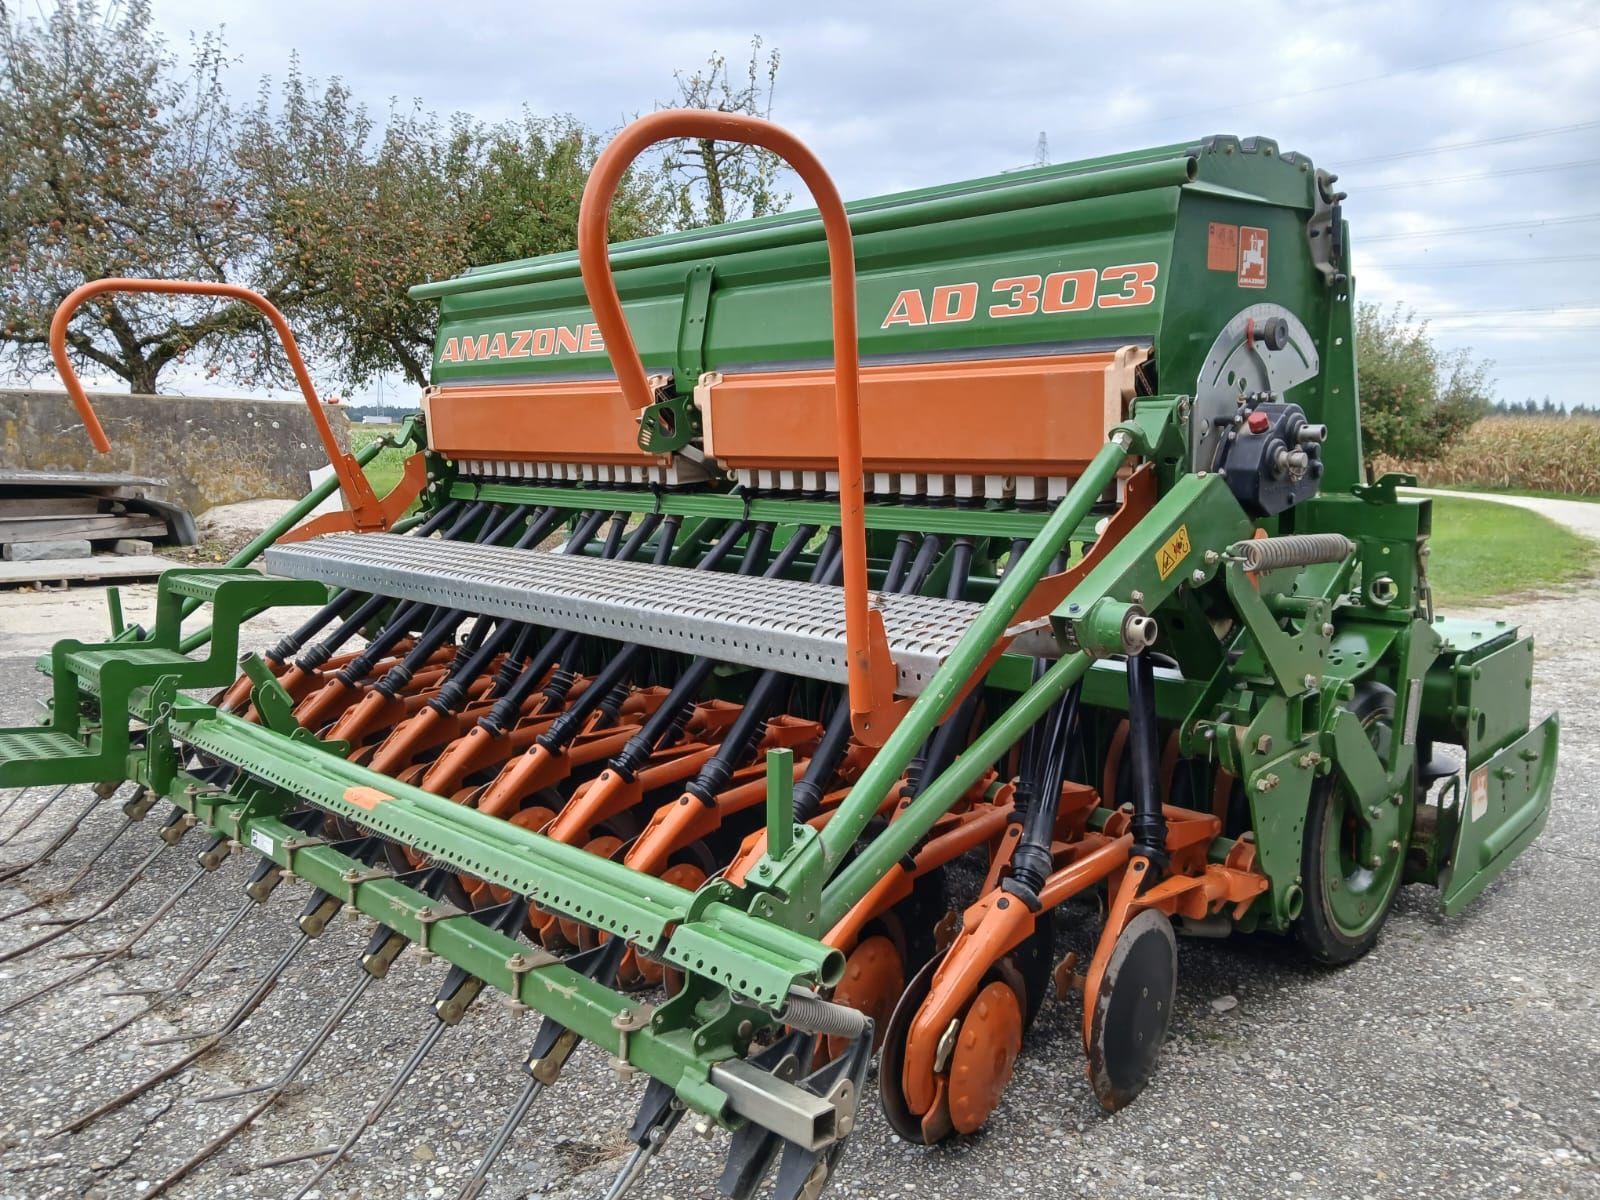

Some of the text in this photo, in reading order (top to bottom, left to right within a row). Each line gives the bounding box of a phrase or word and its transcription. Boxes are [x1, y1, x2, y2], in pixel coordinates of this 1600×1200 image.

[880, 261, 1159, 329] AD 303
[439, 323, 605, 363] AMAZONE
